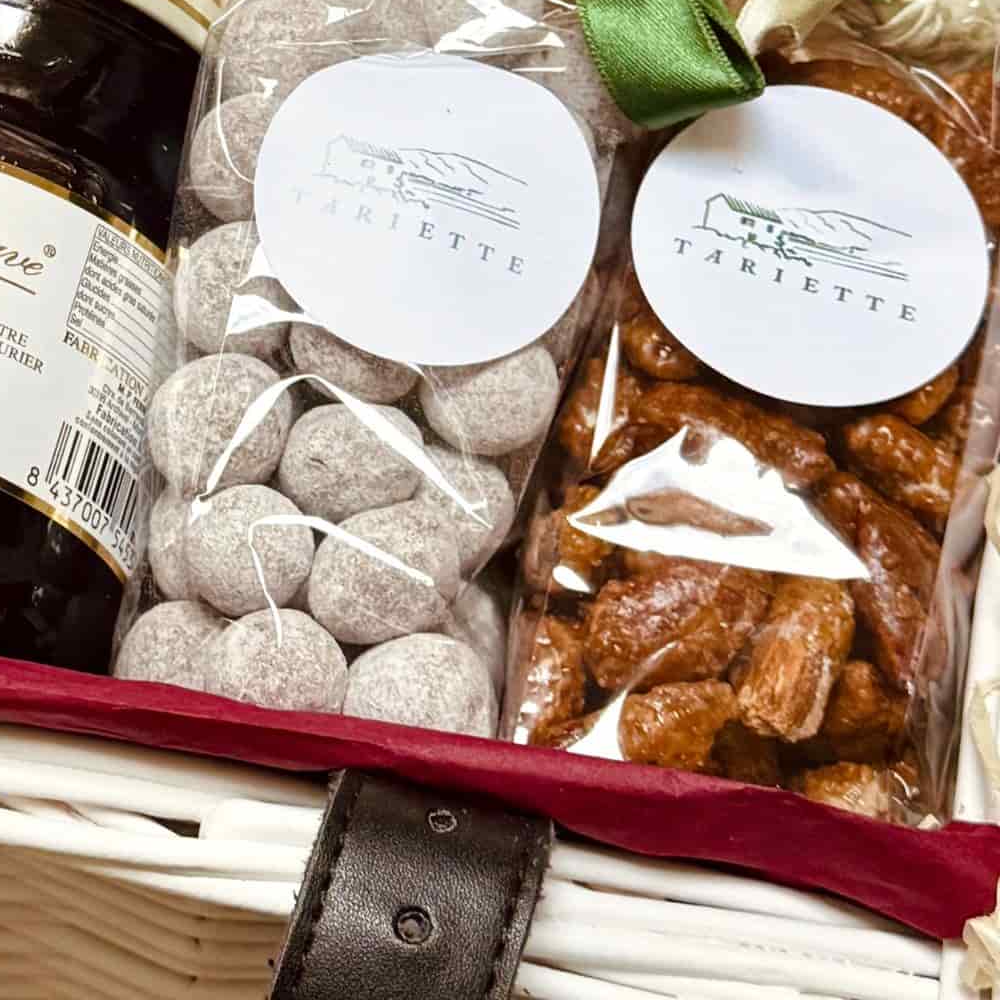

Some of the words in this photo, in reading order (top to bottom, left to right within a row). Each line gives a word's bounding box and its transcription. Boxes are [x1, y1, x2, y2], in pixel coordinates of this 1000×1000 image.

[287, 188, 526, 276] TARIETTE
[672, 236, 918, 324] TARIETTE
[63, 330, 146, 397] FABRCATION
[26, 465, 41, 488] 8
[49, 480, 111, 535] 437007
